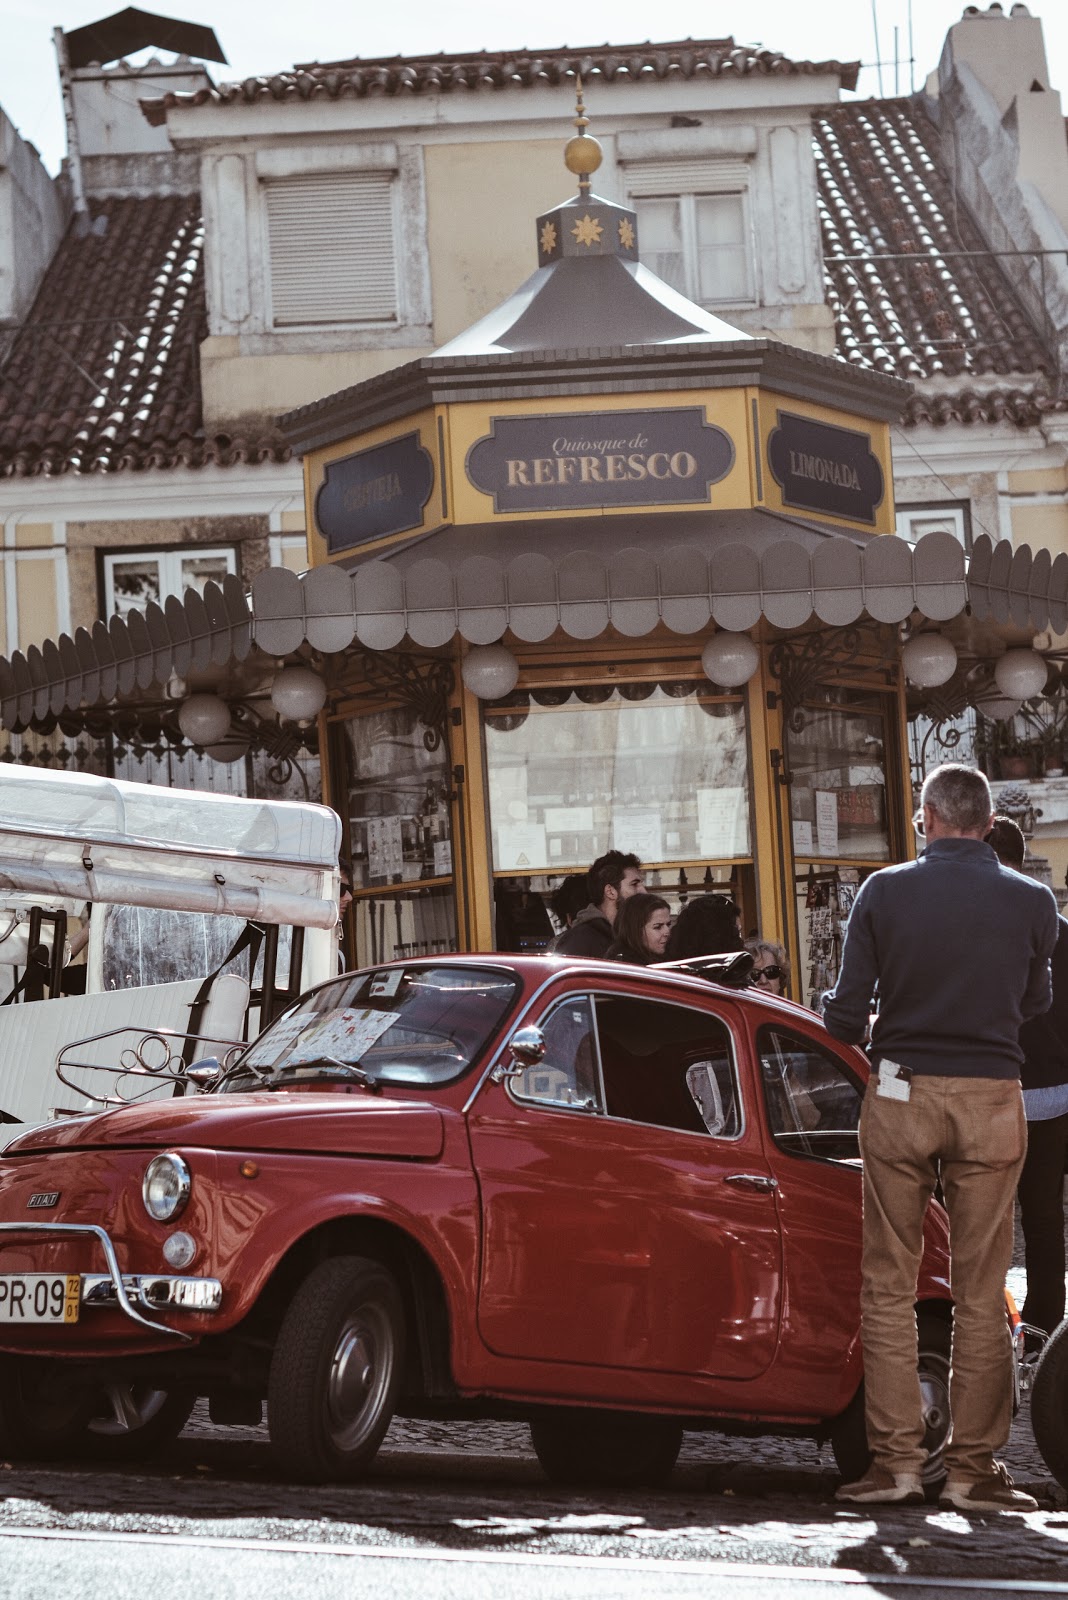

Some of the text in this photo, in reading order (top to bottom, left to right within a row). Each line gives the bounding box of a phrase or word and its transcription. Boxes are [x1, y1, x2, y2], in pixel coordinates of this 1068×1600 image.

[552, 433, 648, 456] Quiosque de
[506, 451, 698, 487] REFRESCO
[789, 450, 861, 490] LIMONADA
[29, 1194, 58, 1207] FIAT
[68, 1280, 79, 1293] 72
[66, 1303, 78, 1317] 01
